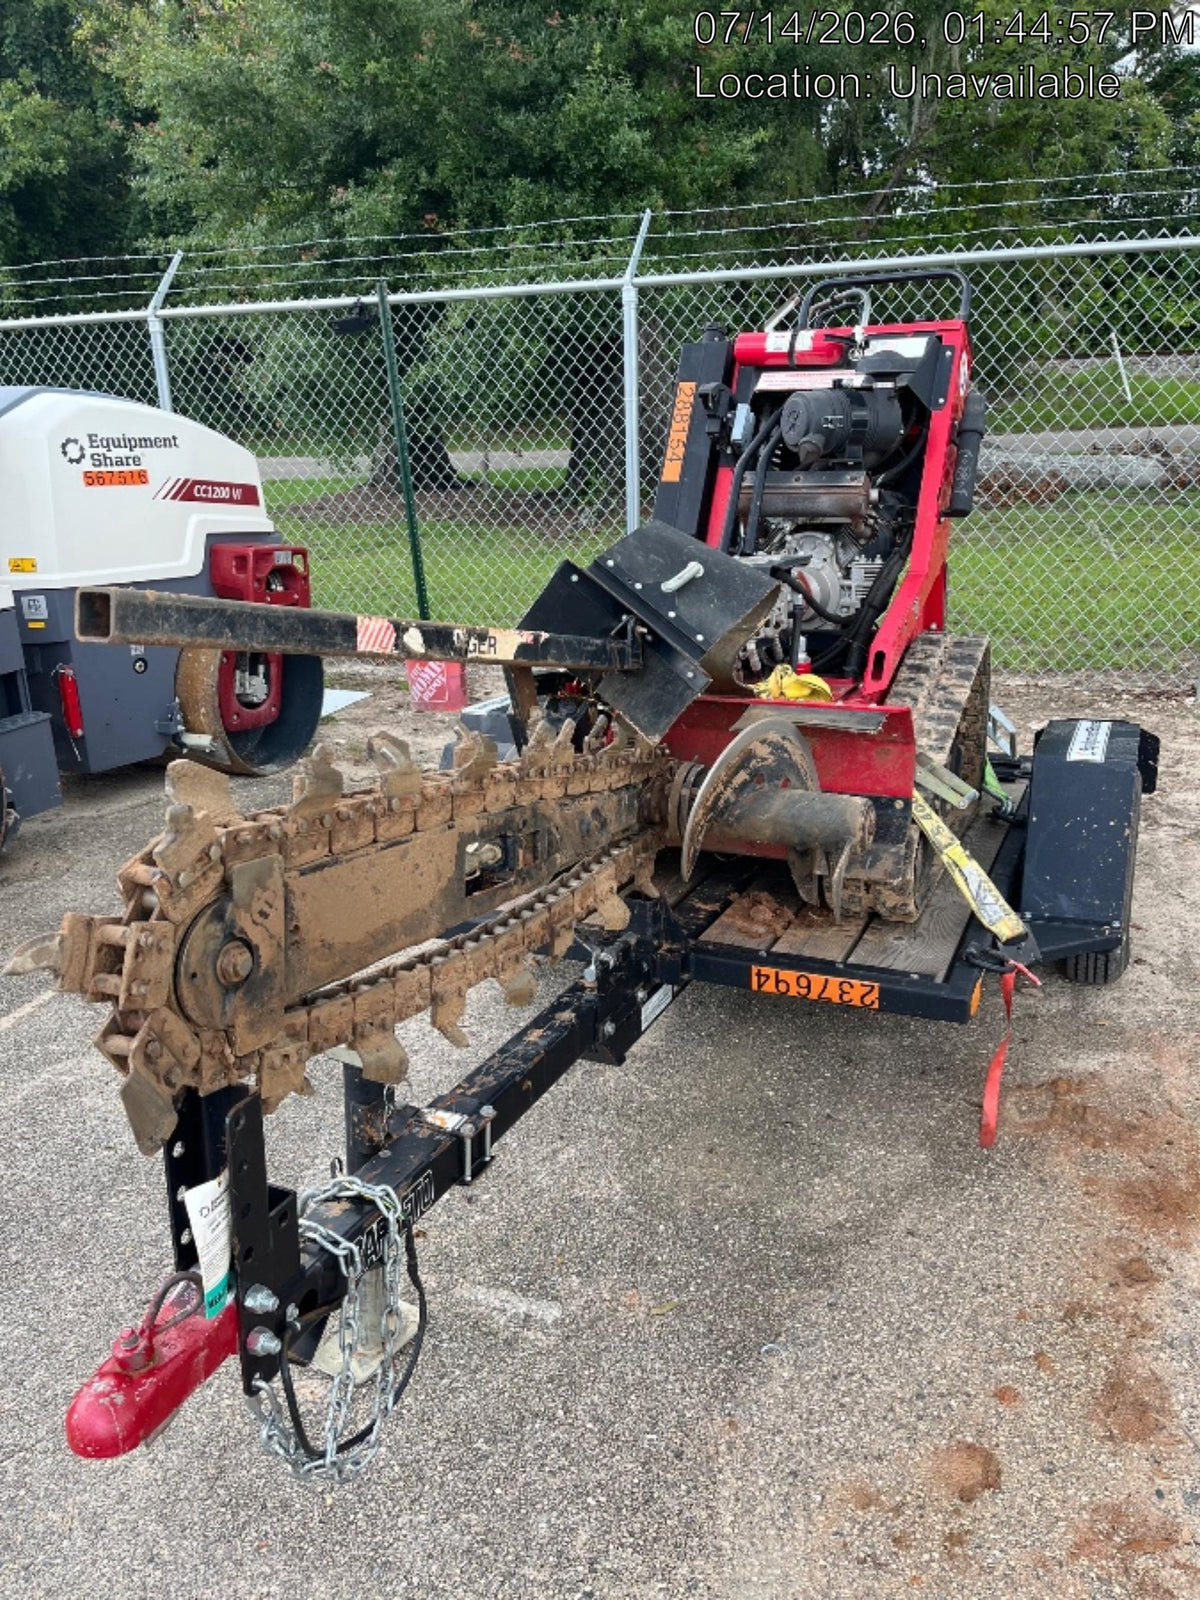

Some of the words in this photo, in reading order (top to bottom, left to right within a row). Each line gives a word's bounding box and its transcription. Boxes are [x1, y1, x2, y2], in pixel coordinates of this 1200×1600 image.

[666, 386, 695, 463] 288154
[87, 433, 179, 452] Equipment
[91, 453, 142, 467] Share
[84, 470, 148, 486] 567516
[193, 484, 230, 499] CC1200
[232, 488, 243, 500] W
[754, 969, 876, 1007] 237694
